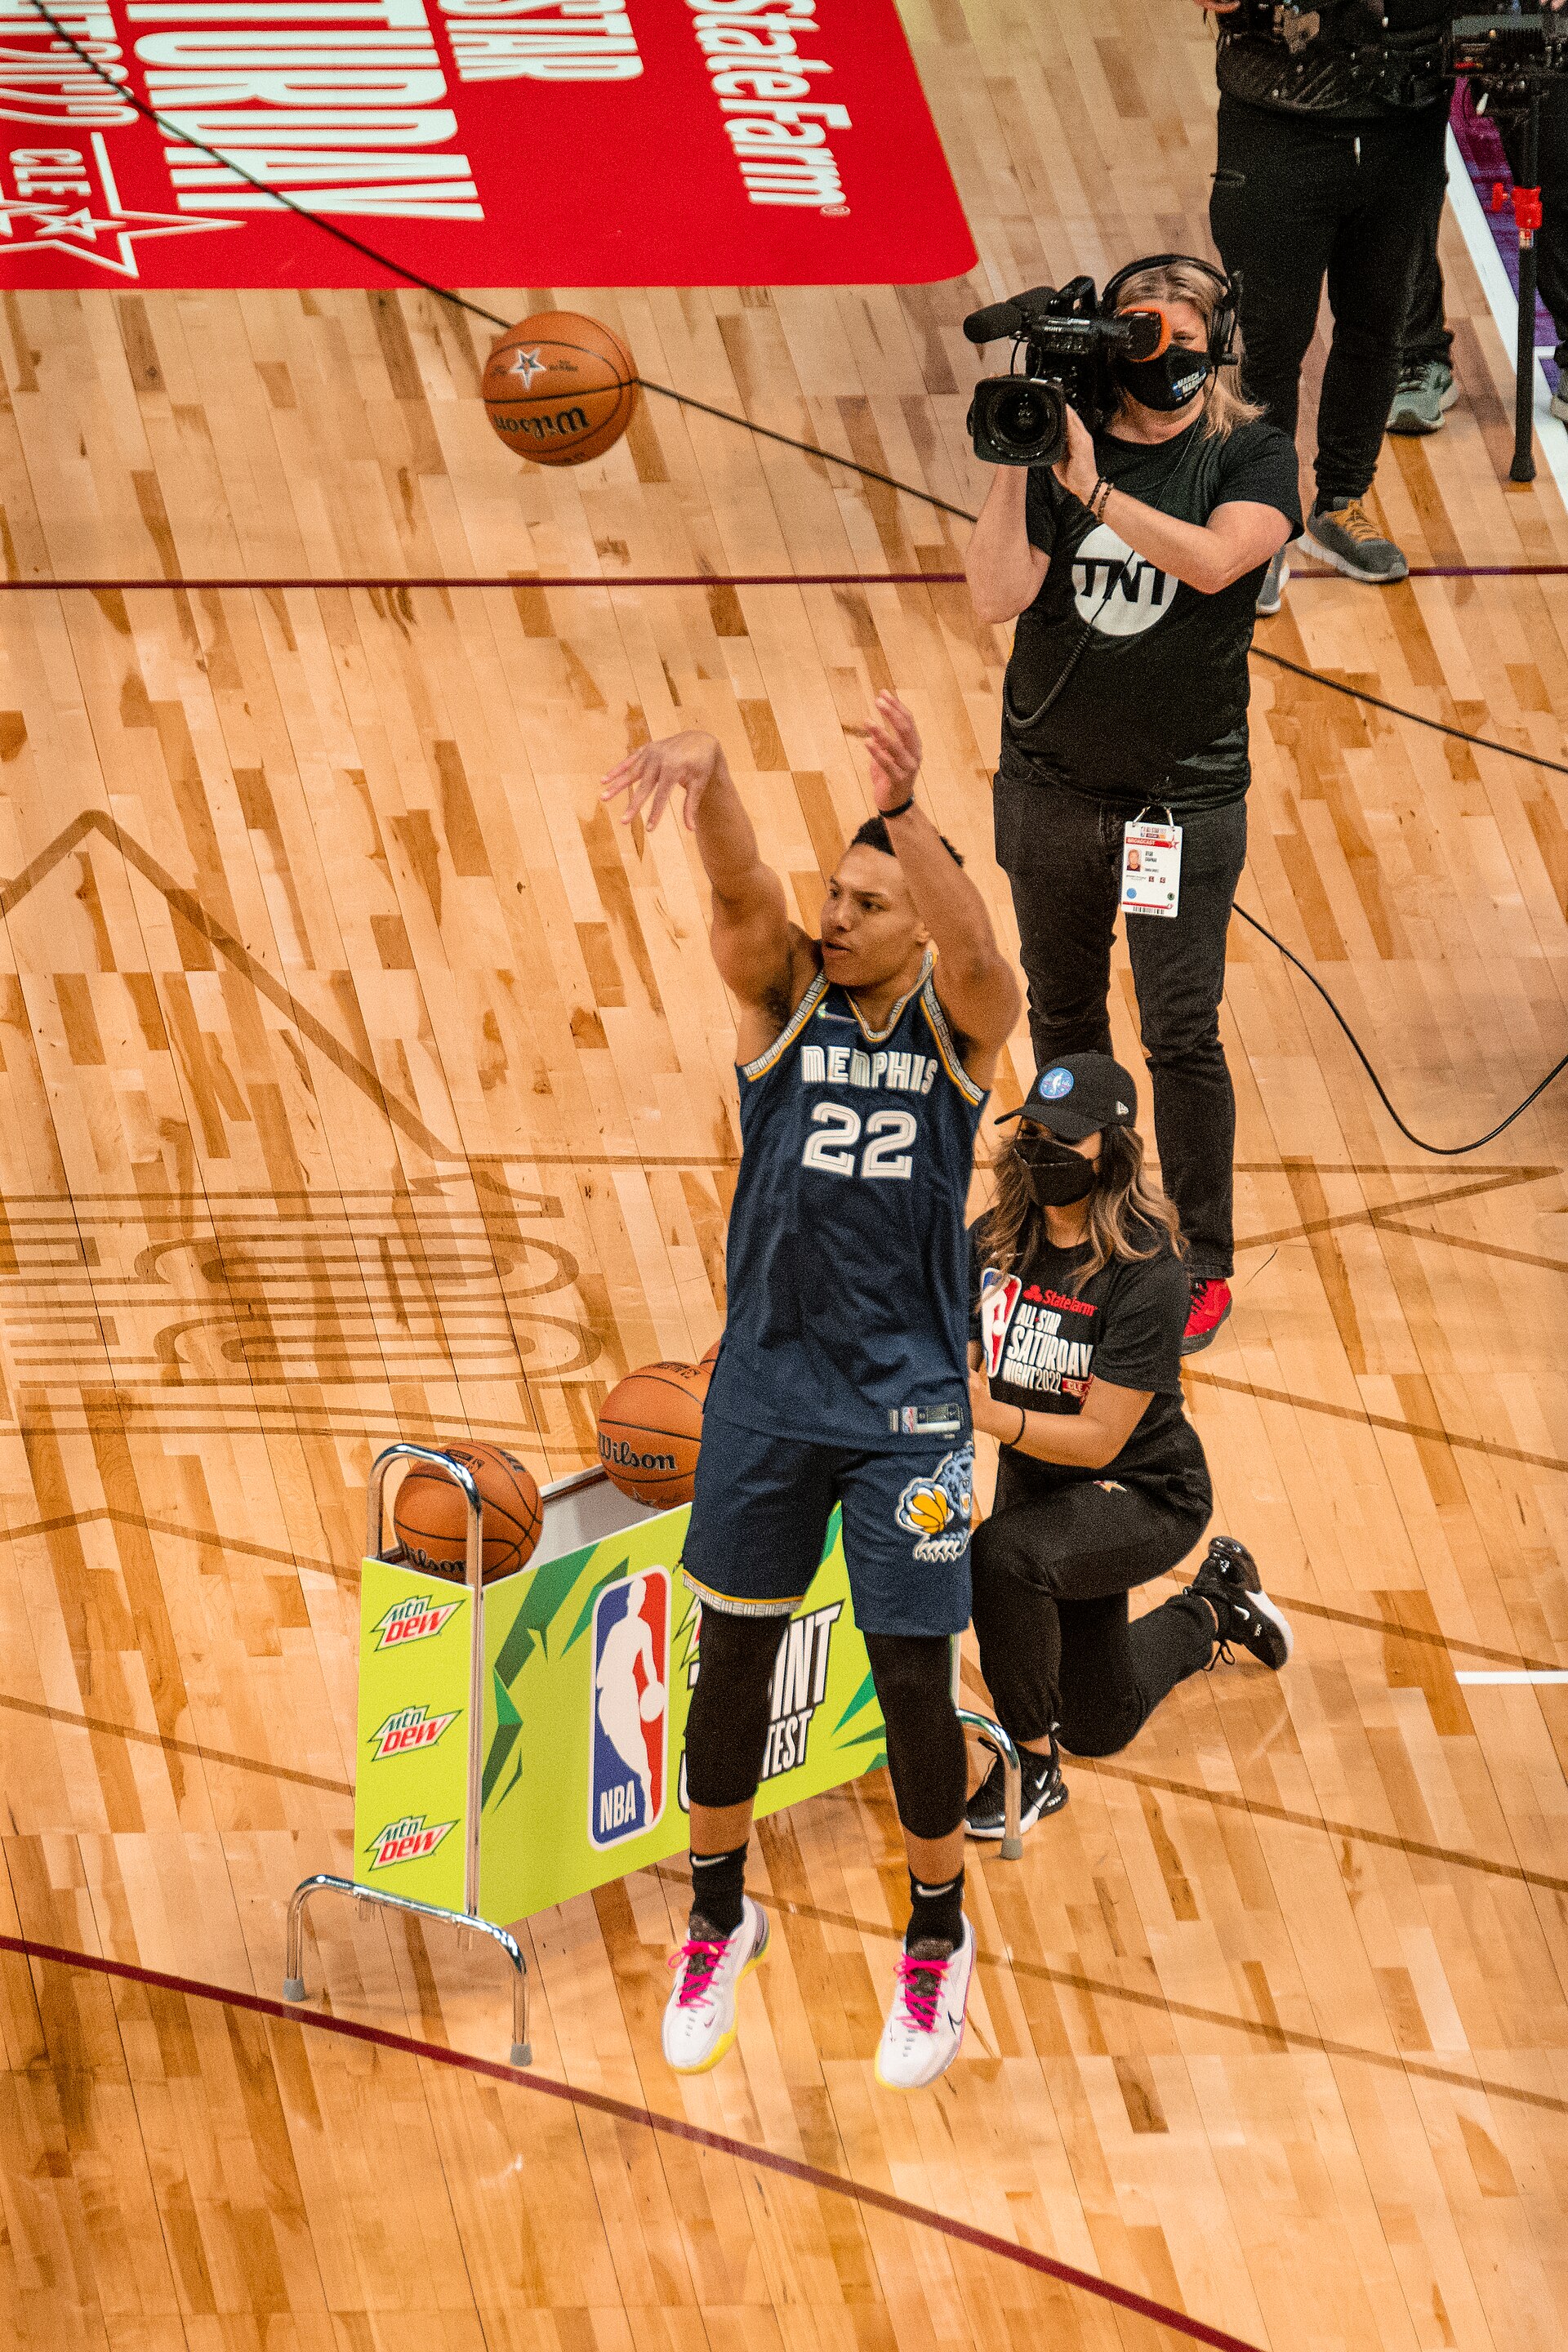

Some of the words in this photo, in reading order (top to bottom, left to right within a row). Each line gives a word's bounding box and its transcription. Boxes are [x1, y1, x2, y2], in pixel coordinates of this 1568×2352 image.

[9, 148, 91, 198] CLE
[493, 406, 590, 443] Wilson
[1071, 557, 1167, 606] TNT
[800, 1045, 938, 1095] MEMPHIS
[800, 1102, 918, 1179] 22
[1006, 1325, 1094, 1379] SATURDAY
[598, 1429, 677, 1471] Wilson
[599, 1780, 637, 1834] NBA
